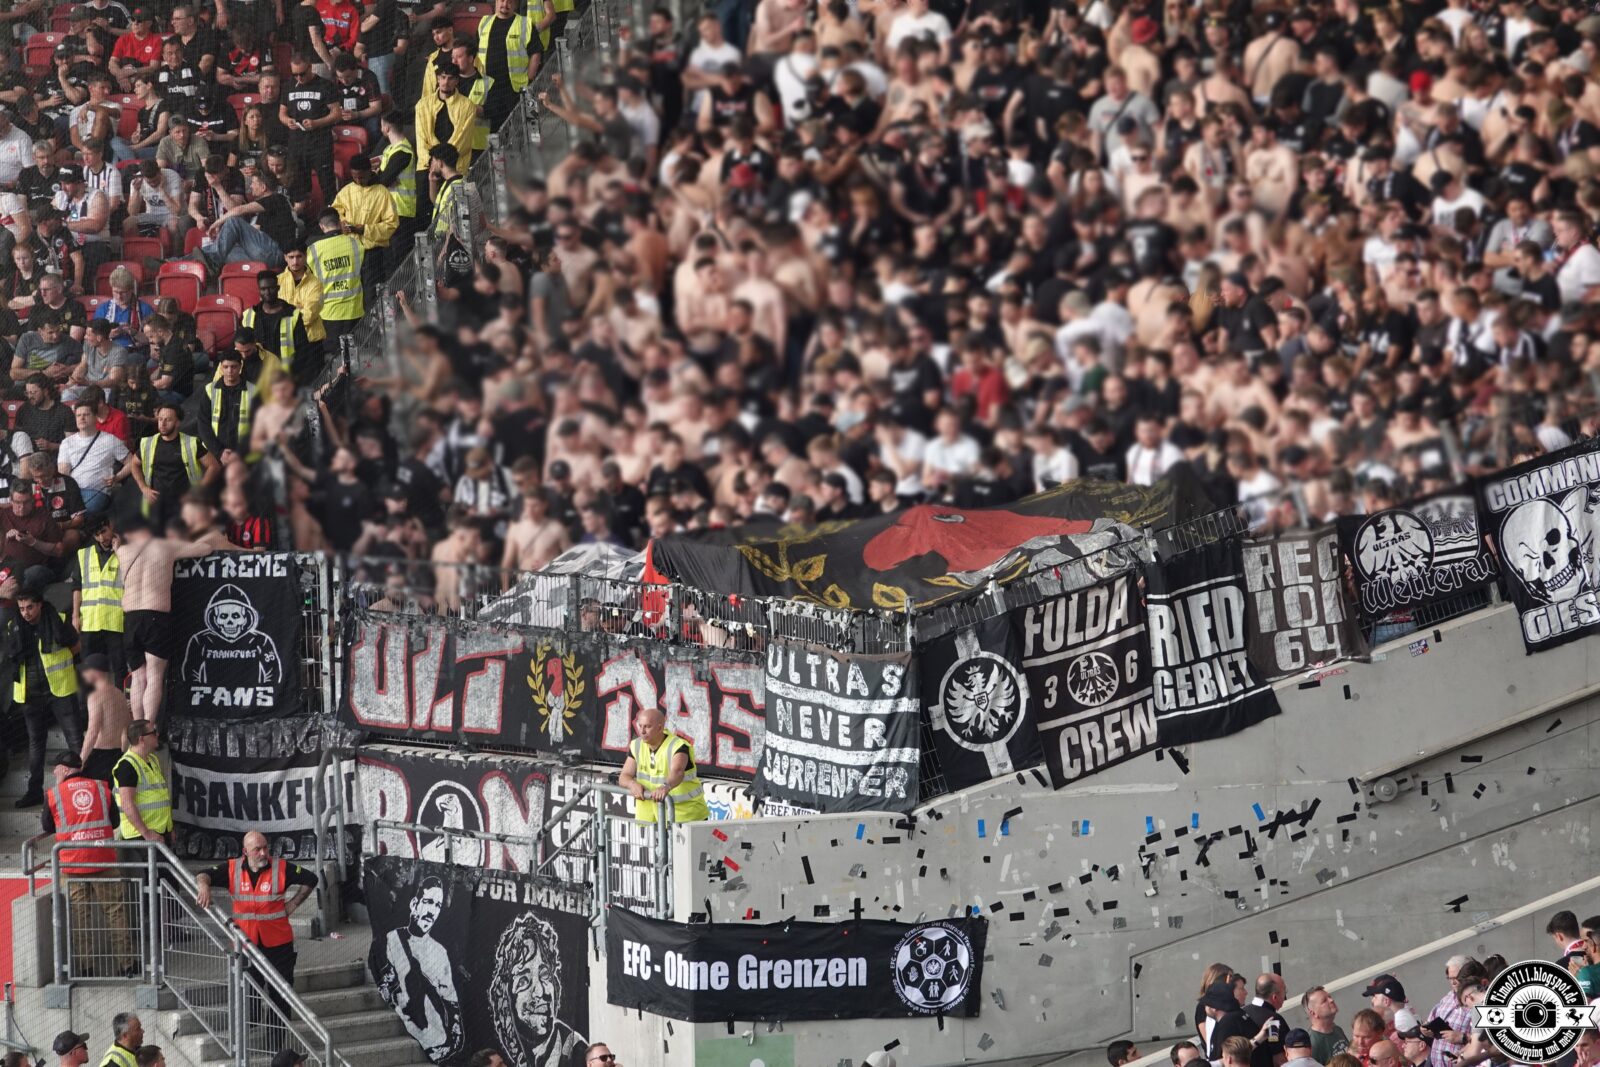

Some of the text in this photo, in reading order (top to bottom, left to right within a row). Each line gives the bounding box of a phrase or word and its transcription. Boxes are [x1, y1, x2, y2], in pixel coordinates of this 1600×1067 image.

[323, 255, 351, 271] SECURITY
[1487, 451, 1600, 513] COMMAN
[174, 553, 289, 578] EXTREME
[1372, 531, 1411, 552] ULTRAS
[1023, 575, 1129, 658] FULDA
[1147, 585, 1245, 668] RIED
[1521, 590, 1600, 644] GIES
[206, 648, 257, 659] FRANKFURT
[766, 643, 904, 698] ULTRAS
[1274, 623, 1343, 671] 64
[191, 686, 274, 706] FANS
[1080, 666, 1101, 681] ULTRAS
[1153, 651, 1256, 712] GEBIET
[776, 697, 888, 749] NEVER
[1059, 697, 1159, 780] CREW
[764, 803, 789, 817] FREE
[622, 939, 651, 981] EFC
[664, 949, 730, 991] Ohne
[736, 953, 868, 991] Grenzen
